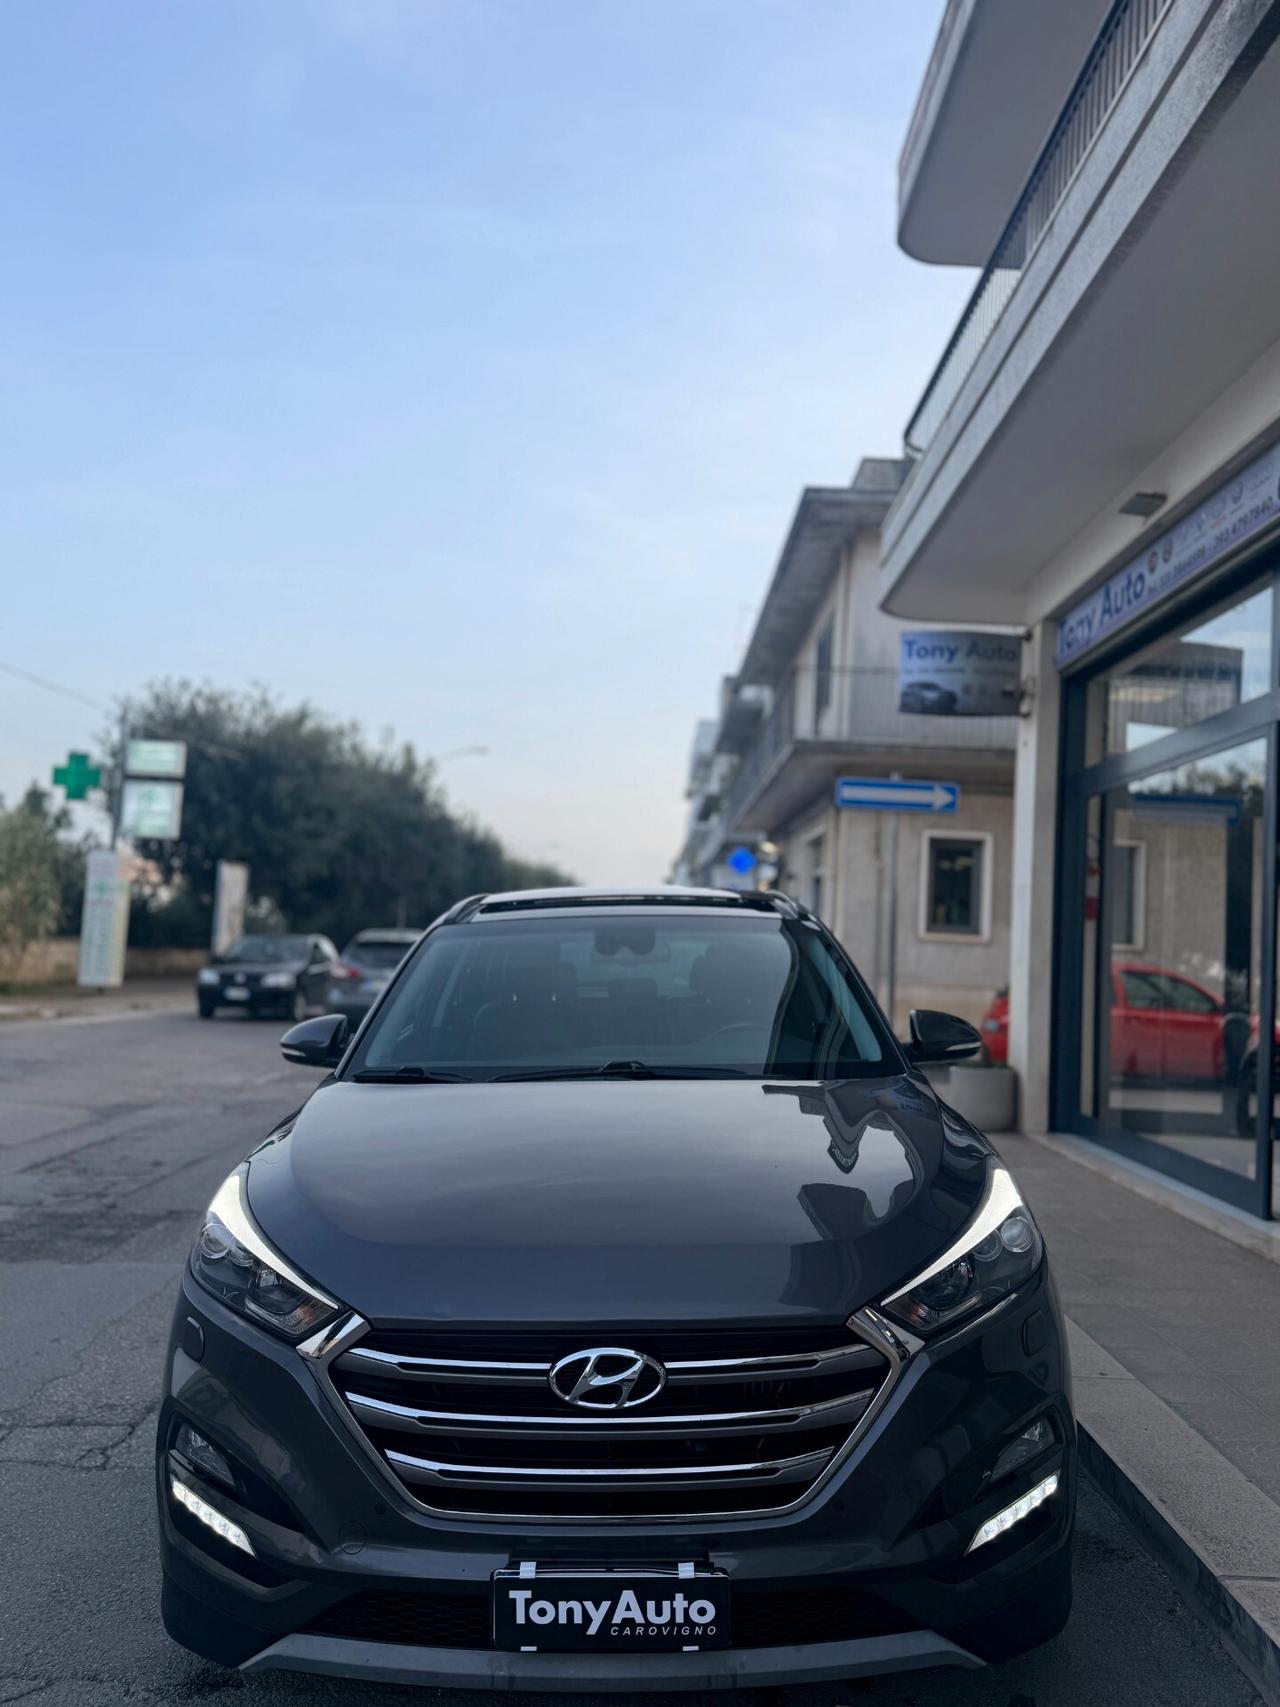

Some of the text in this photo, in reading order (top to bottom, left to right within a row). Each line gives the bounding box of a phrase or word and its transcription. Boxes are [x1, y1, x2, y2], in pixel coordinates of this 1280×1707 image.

[1100, 572, 1145, 628] Auto
[904, 640, 1017, 664] Tony Auto
[610, 1626, 716, 1636] CAROVIGNO
